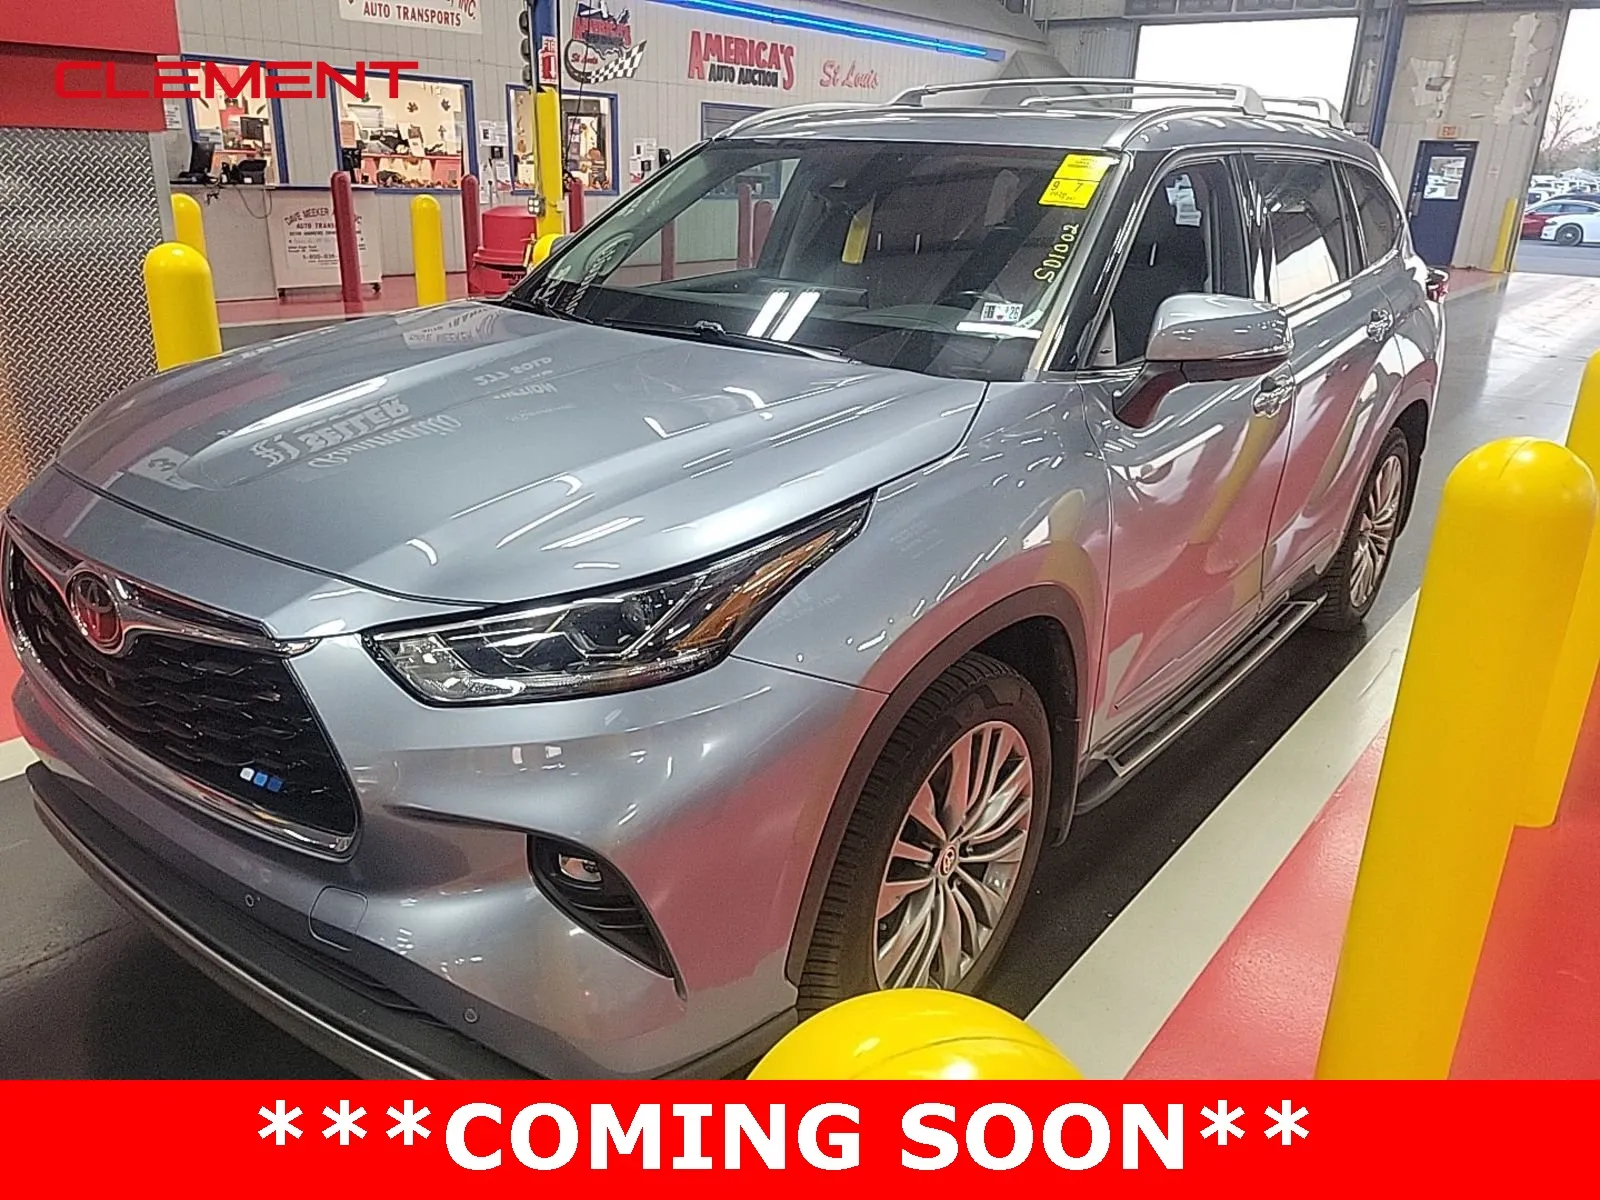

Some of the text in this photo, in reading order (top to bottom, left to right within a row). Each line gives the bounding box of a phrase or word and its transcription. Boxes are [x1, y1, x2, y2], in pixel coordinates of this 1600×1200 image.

[363, 1, 461, 27] AUTO TRANSPORTS
[688, 30, 795, 91] AMERICA'S
[708, 63, 779, 88] AUTO AUCTION
[819, 60, 880, 90] St Louis
[1033, 223, 1080, 283] S01002
